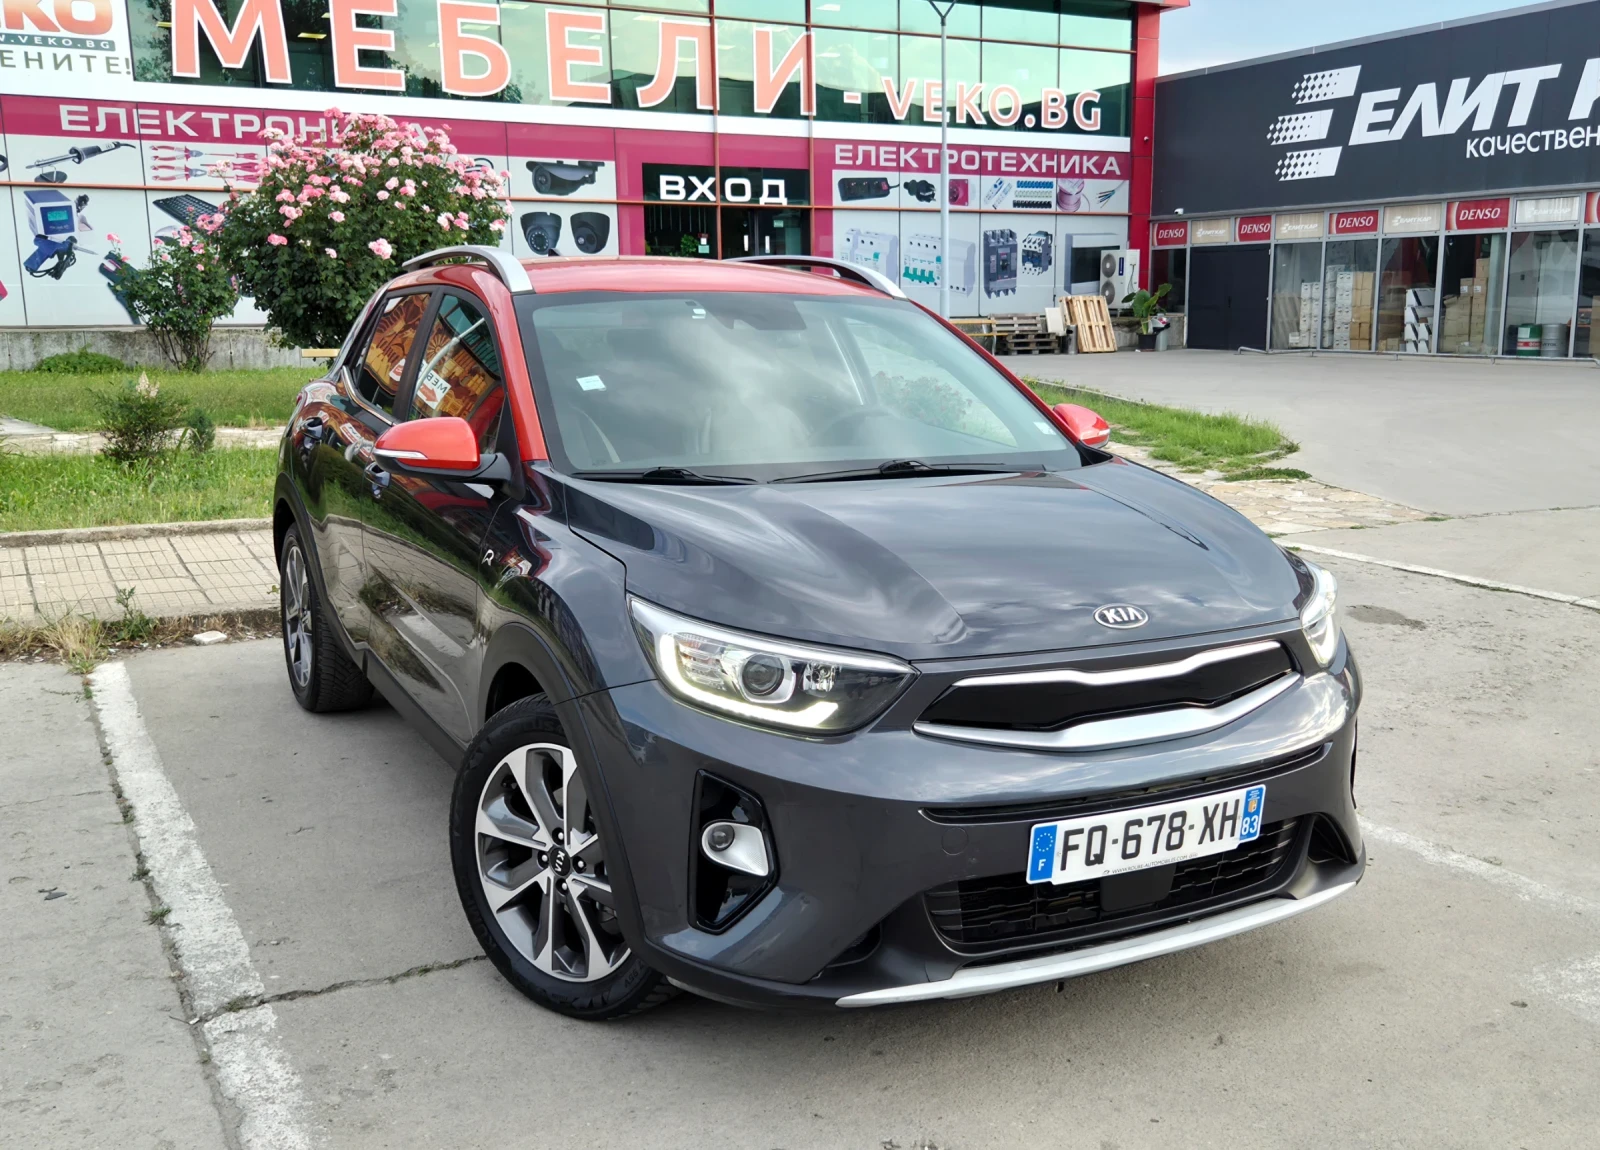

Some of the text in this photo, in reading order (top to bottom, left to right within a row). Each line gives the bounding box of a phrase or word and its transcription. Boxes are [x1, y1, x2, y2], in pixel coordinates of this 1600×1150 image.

[0, 0, 113, 35] KO
[171, 0, 816, 116] МЕБЕЛИ
[881, 76, 1101, 131] VEKO.BG
[1348, 63, 1563, 146] ЕЛИТ
[1465, 125, 1600, 159] качествен
[835, 144, 1121, 176] ЕЛЕКТРОТЕХНИКА
[659, 174, 788, 206] ВХОД
[1338, 216, 1374, 228] DENSO
[1459, 207, 1501, 221] DENSO
[1158, 228, 1185, 239] DENSO
[1240, 222, 1271, 234] DENSO
[1101, 606, 1143, 624] KIA
[1060, 799, 1240, 871] FQ-678-XH
[1241, 815, 1258, 835] 83
[555, 850, 566, 871] KIA
[1038, 858, 1046, 871] F
